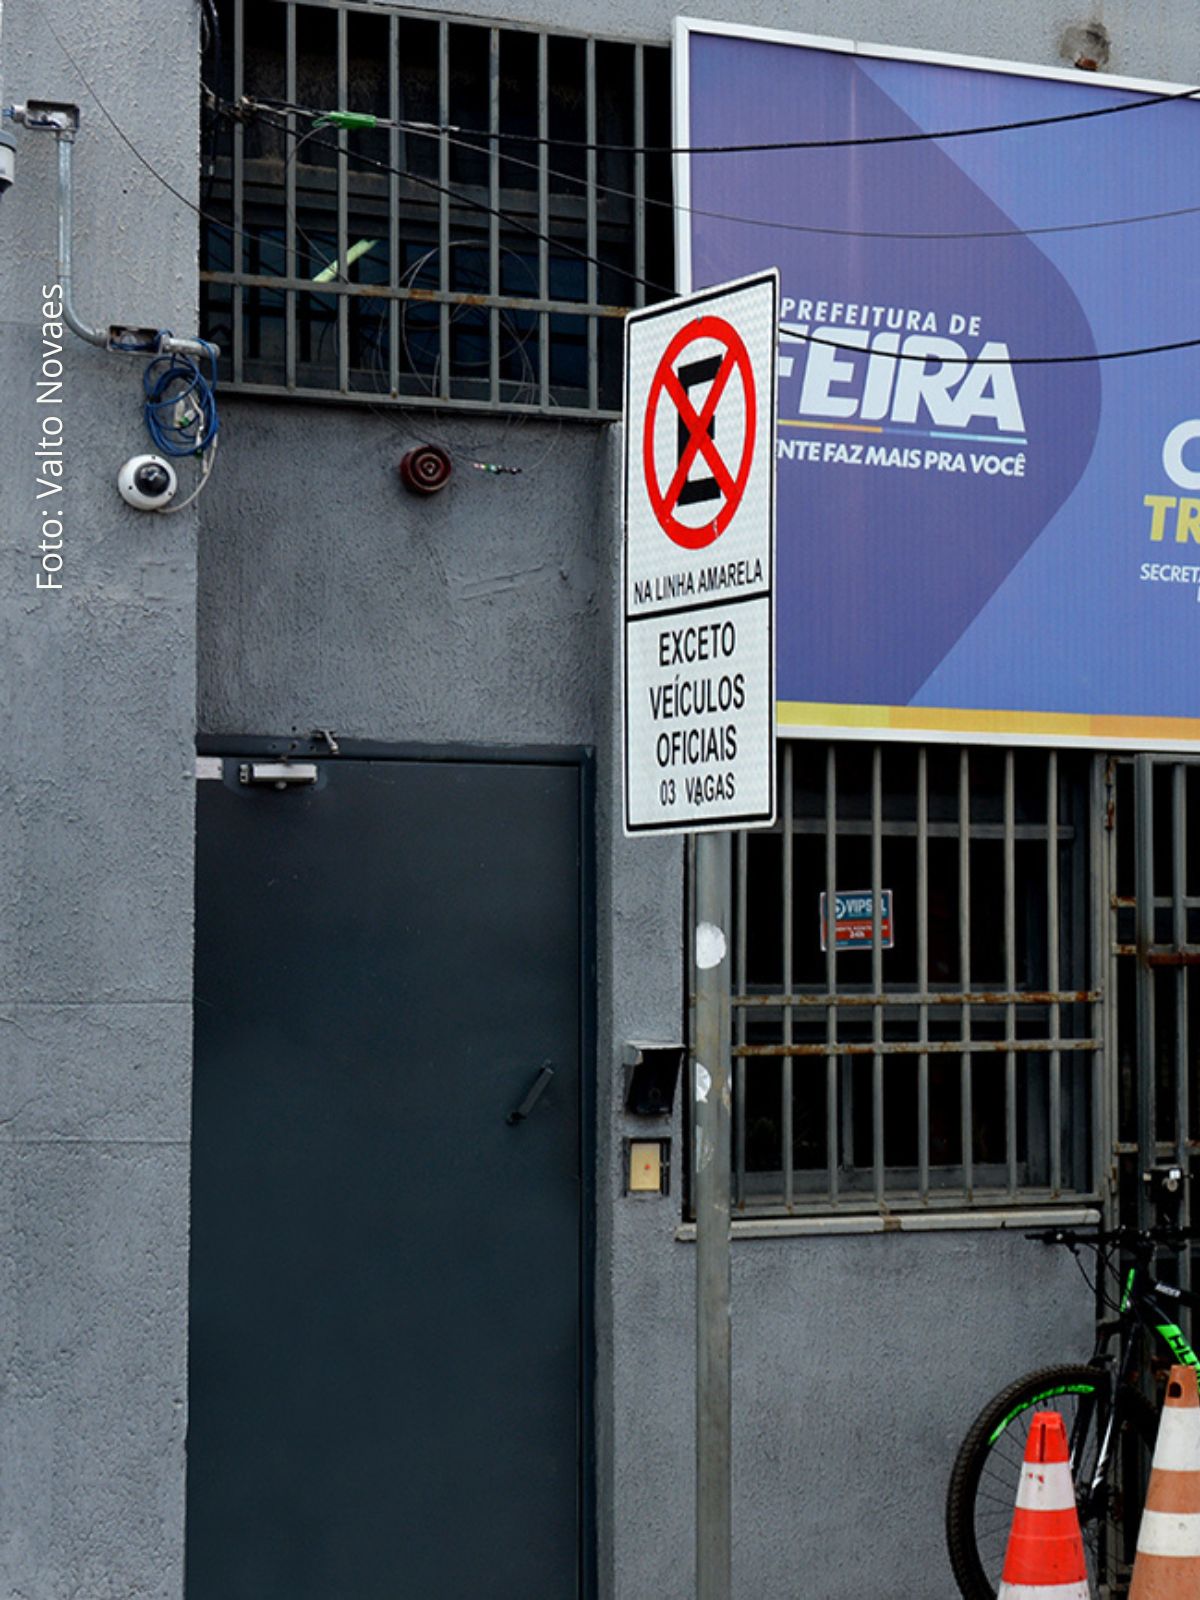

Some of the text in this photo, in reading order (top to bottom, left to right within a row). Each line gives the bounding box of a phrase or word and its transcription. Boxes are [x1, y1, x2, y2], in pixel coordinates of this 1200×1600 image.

[780, 298, 982, 336] PREFEITURA DE
[777, 439, 1026, 477] NTE FAZ MAIS PRA VOCÊ
[634, 558, 764, 605] NA LINHA AMARELA
[659, 620, 736, 667] EXCETO
[649, 672, 746, 721] VEÍCULOS
[656, 723, 737, 768] OFICIAIS
[659, 771, 736, 806] 03 VAGAS
[846, 898, 887, 912] VIPSL
